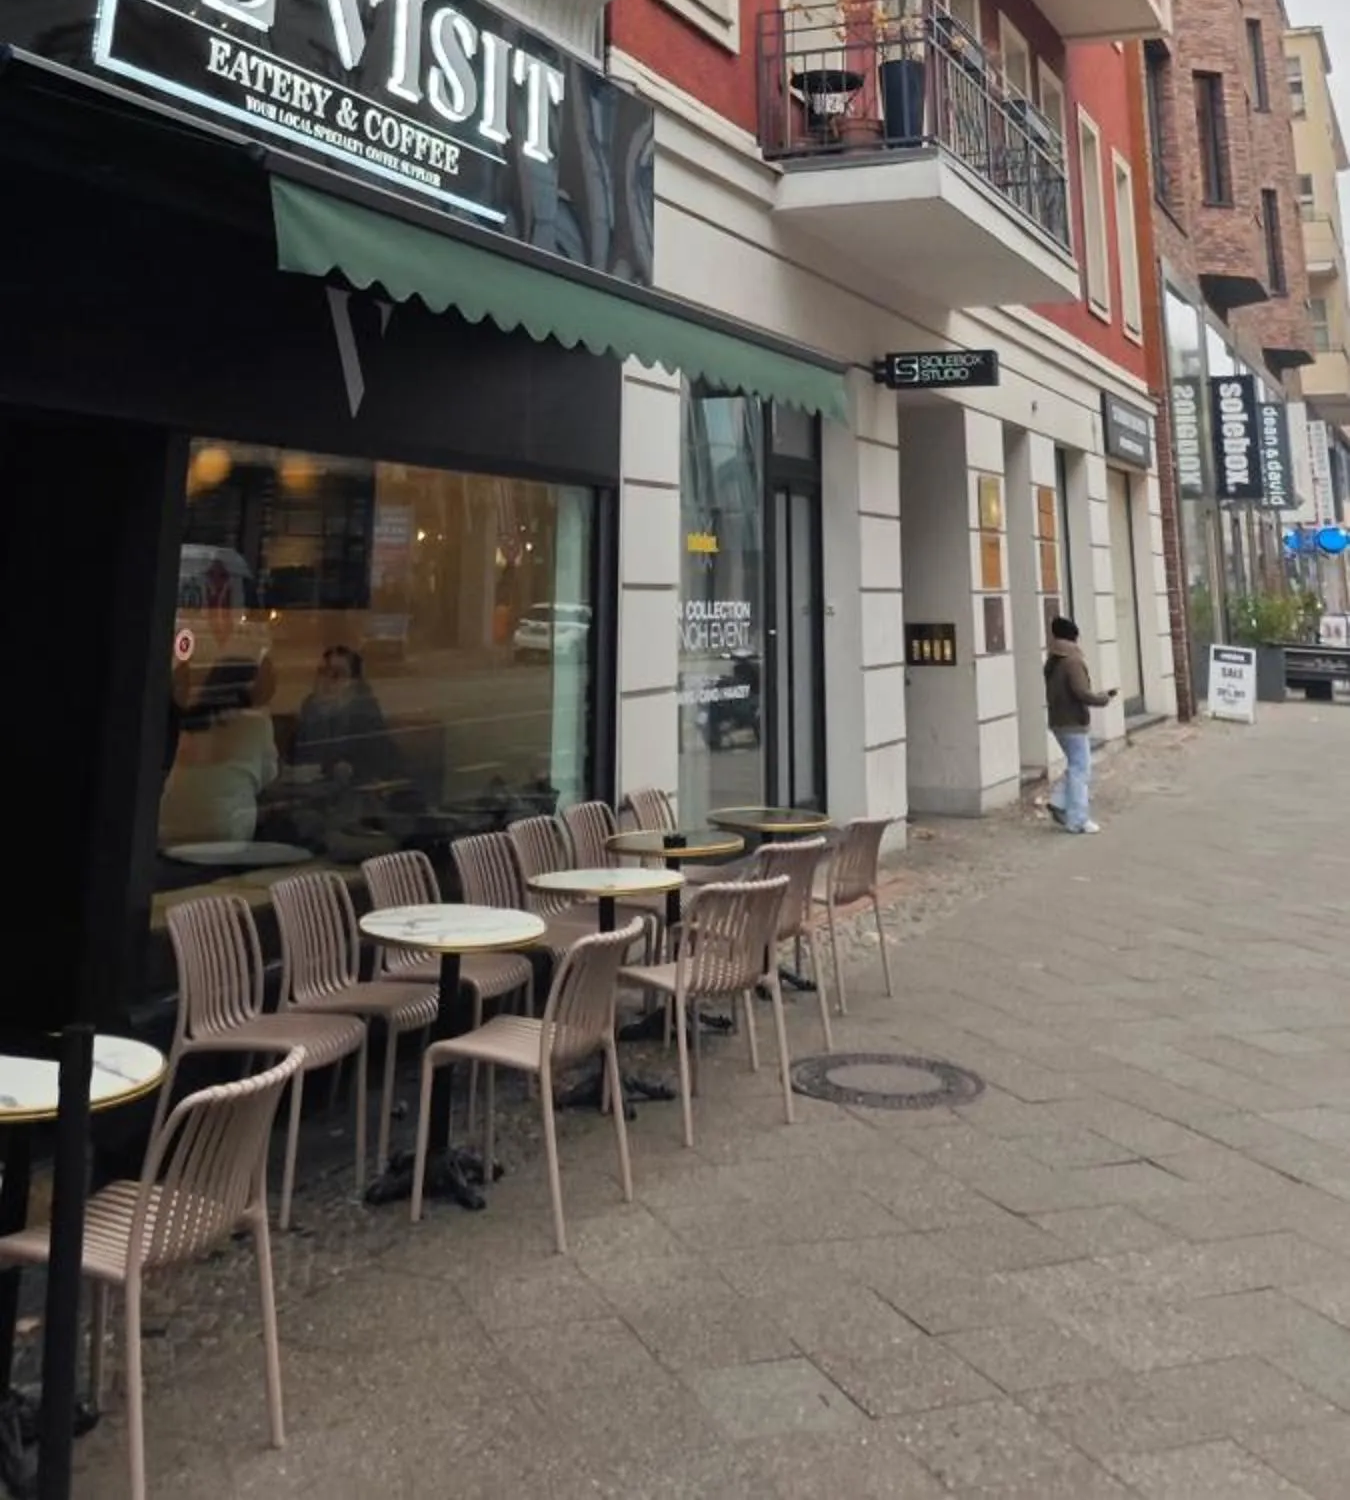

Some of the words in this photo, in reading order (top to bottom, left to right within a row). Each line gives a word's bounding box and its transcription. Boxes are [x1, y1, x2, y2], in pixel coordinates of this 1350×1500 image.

[207, 37, 333, 119] EATERY
[335, 97, 360, 132] &
[363, 108, 462, 175] COFFEE
[278, 106, 313, 135] LOCAL
[365, 144, 400, 169] COFFEE
[920, 367, 970, 381] STUDIO
[921, 353, 980, 368] SOLEBOX
[1219, 383, 1250, 493] solebox.
[685, 600, 751, 620] COLLECTION
[711, 621, 751, 649] EVENT
